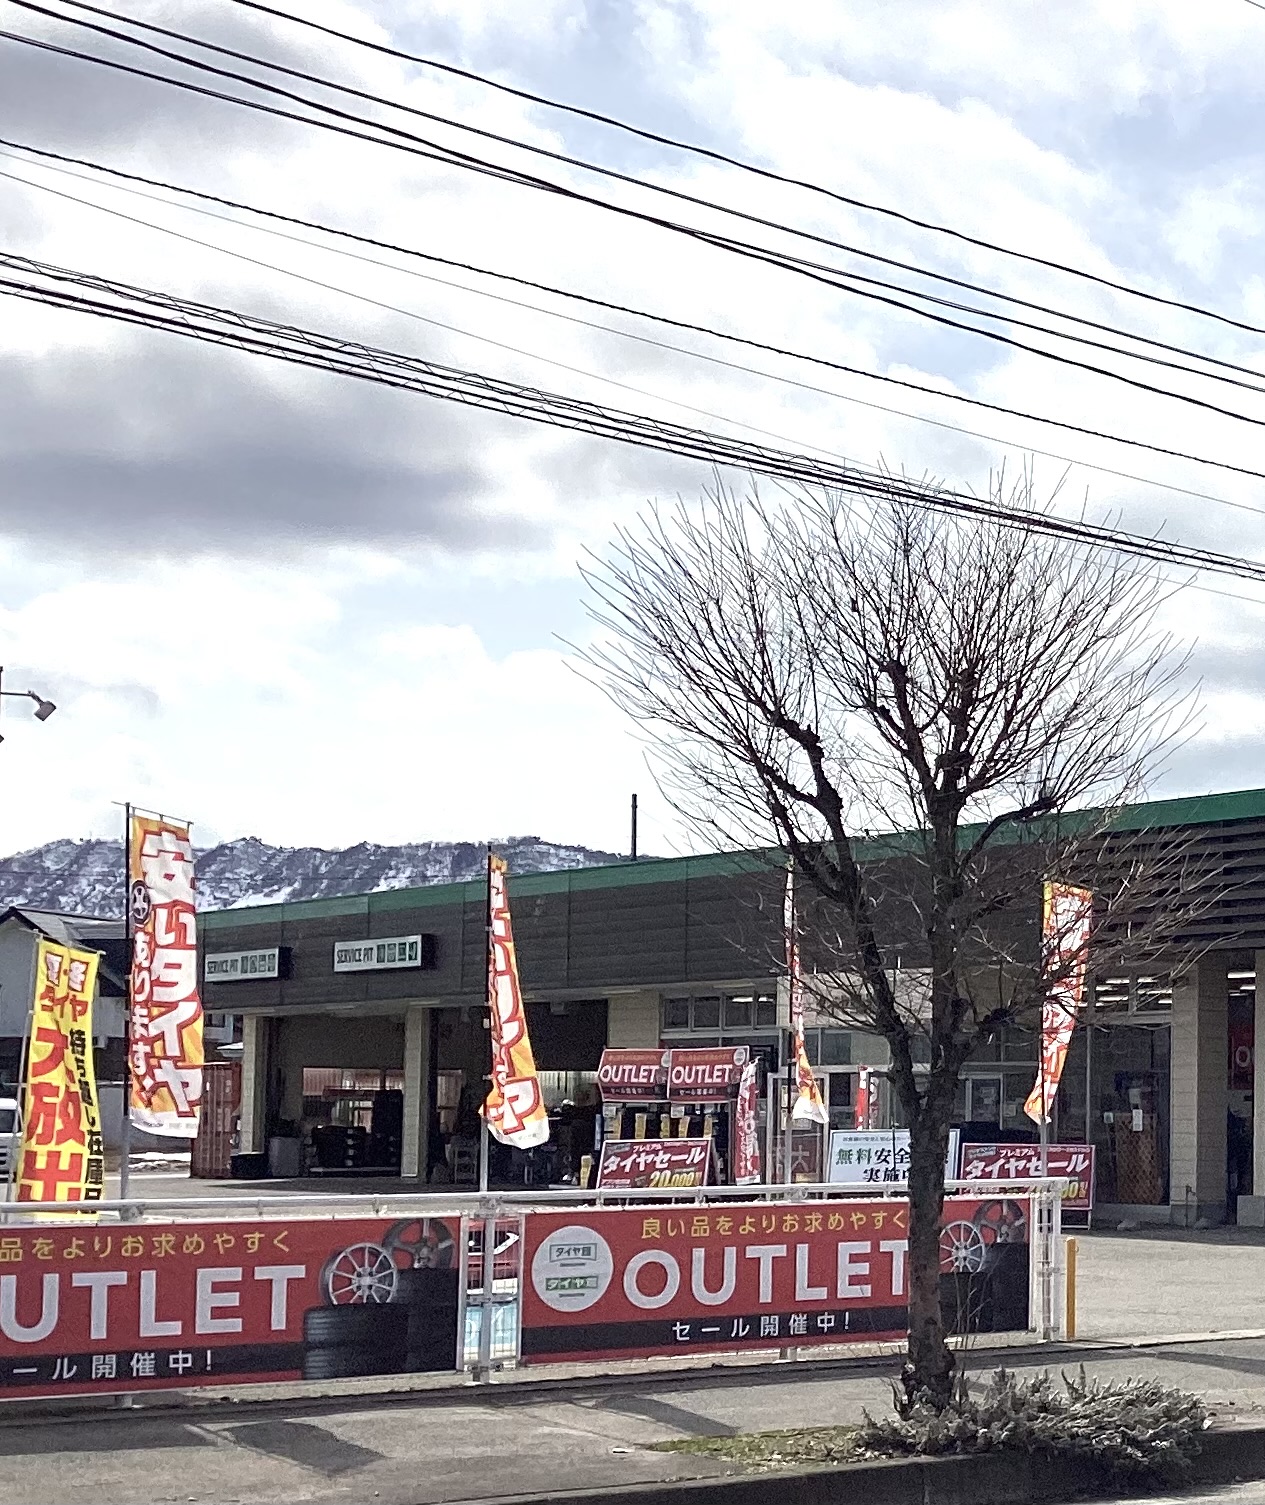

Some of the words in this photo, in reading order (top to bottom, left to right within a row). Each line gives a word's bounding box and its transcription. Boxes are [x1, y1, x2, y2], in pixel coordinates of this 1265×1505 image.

[600, 1064, 660, 1084] OUTLET
[672, 1064, 733, 1084] OUTLET
[604, 1147, 706, 1175] タイヤセール
[836, 1148, 948, 1165] 無料安全
[965, 1154, 1090, 1180] タイヤセール
[641, 1208, 907, 1240] 良い品をよりお求めやすく
[0, 1231, 291, 1262] 品をよりお求めやすく
[623, 1240, 910, 1310] OUTLET
[672, 1311, 851, 1342] セール開催中!
[12, 1350, 213, 1380] ール開催中!
